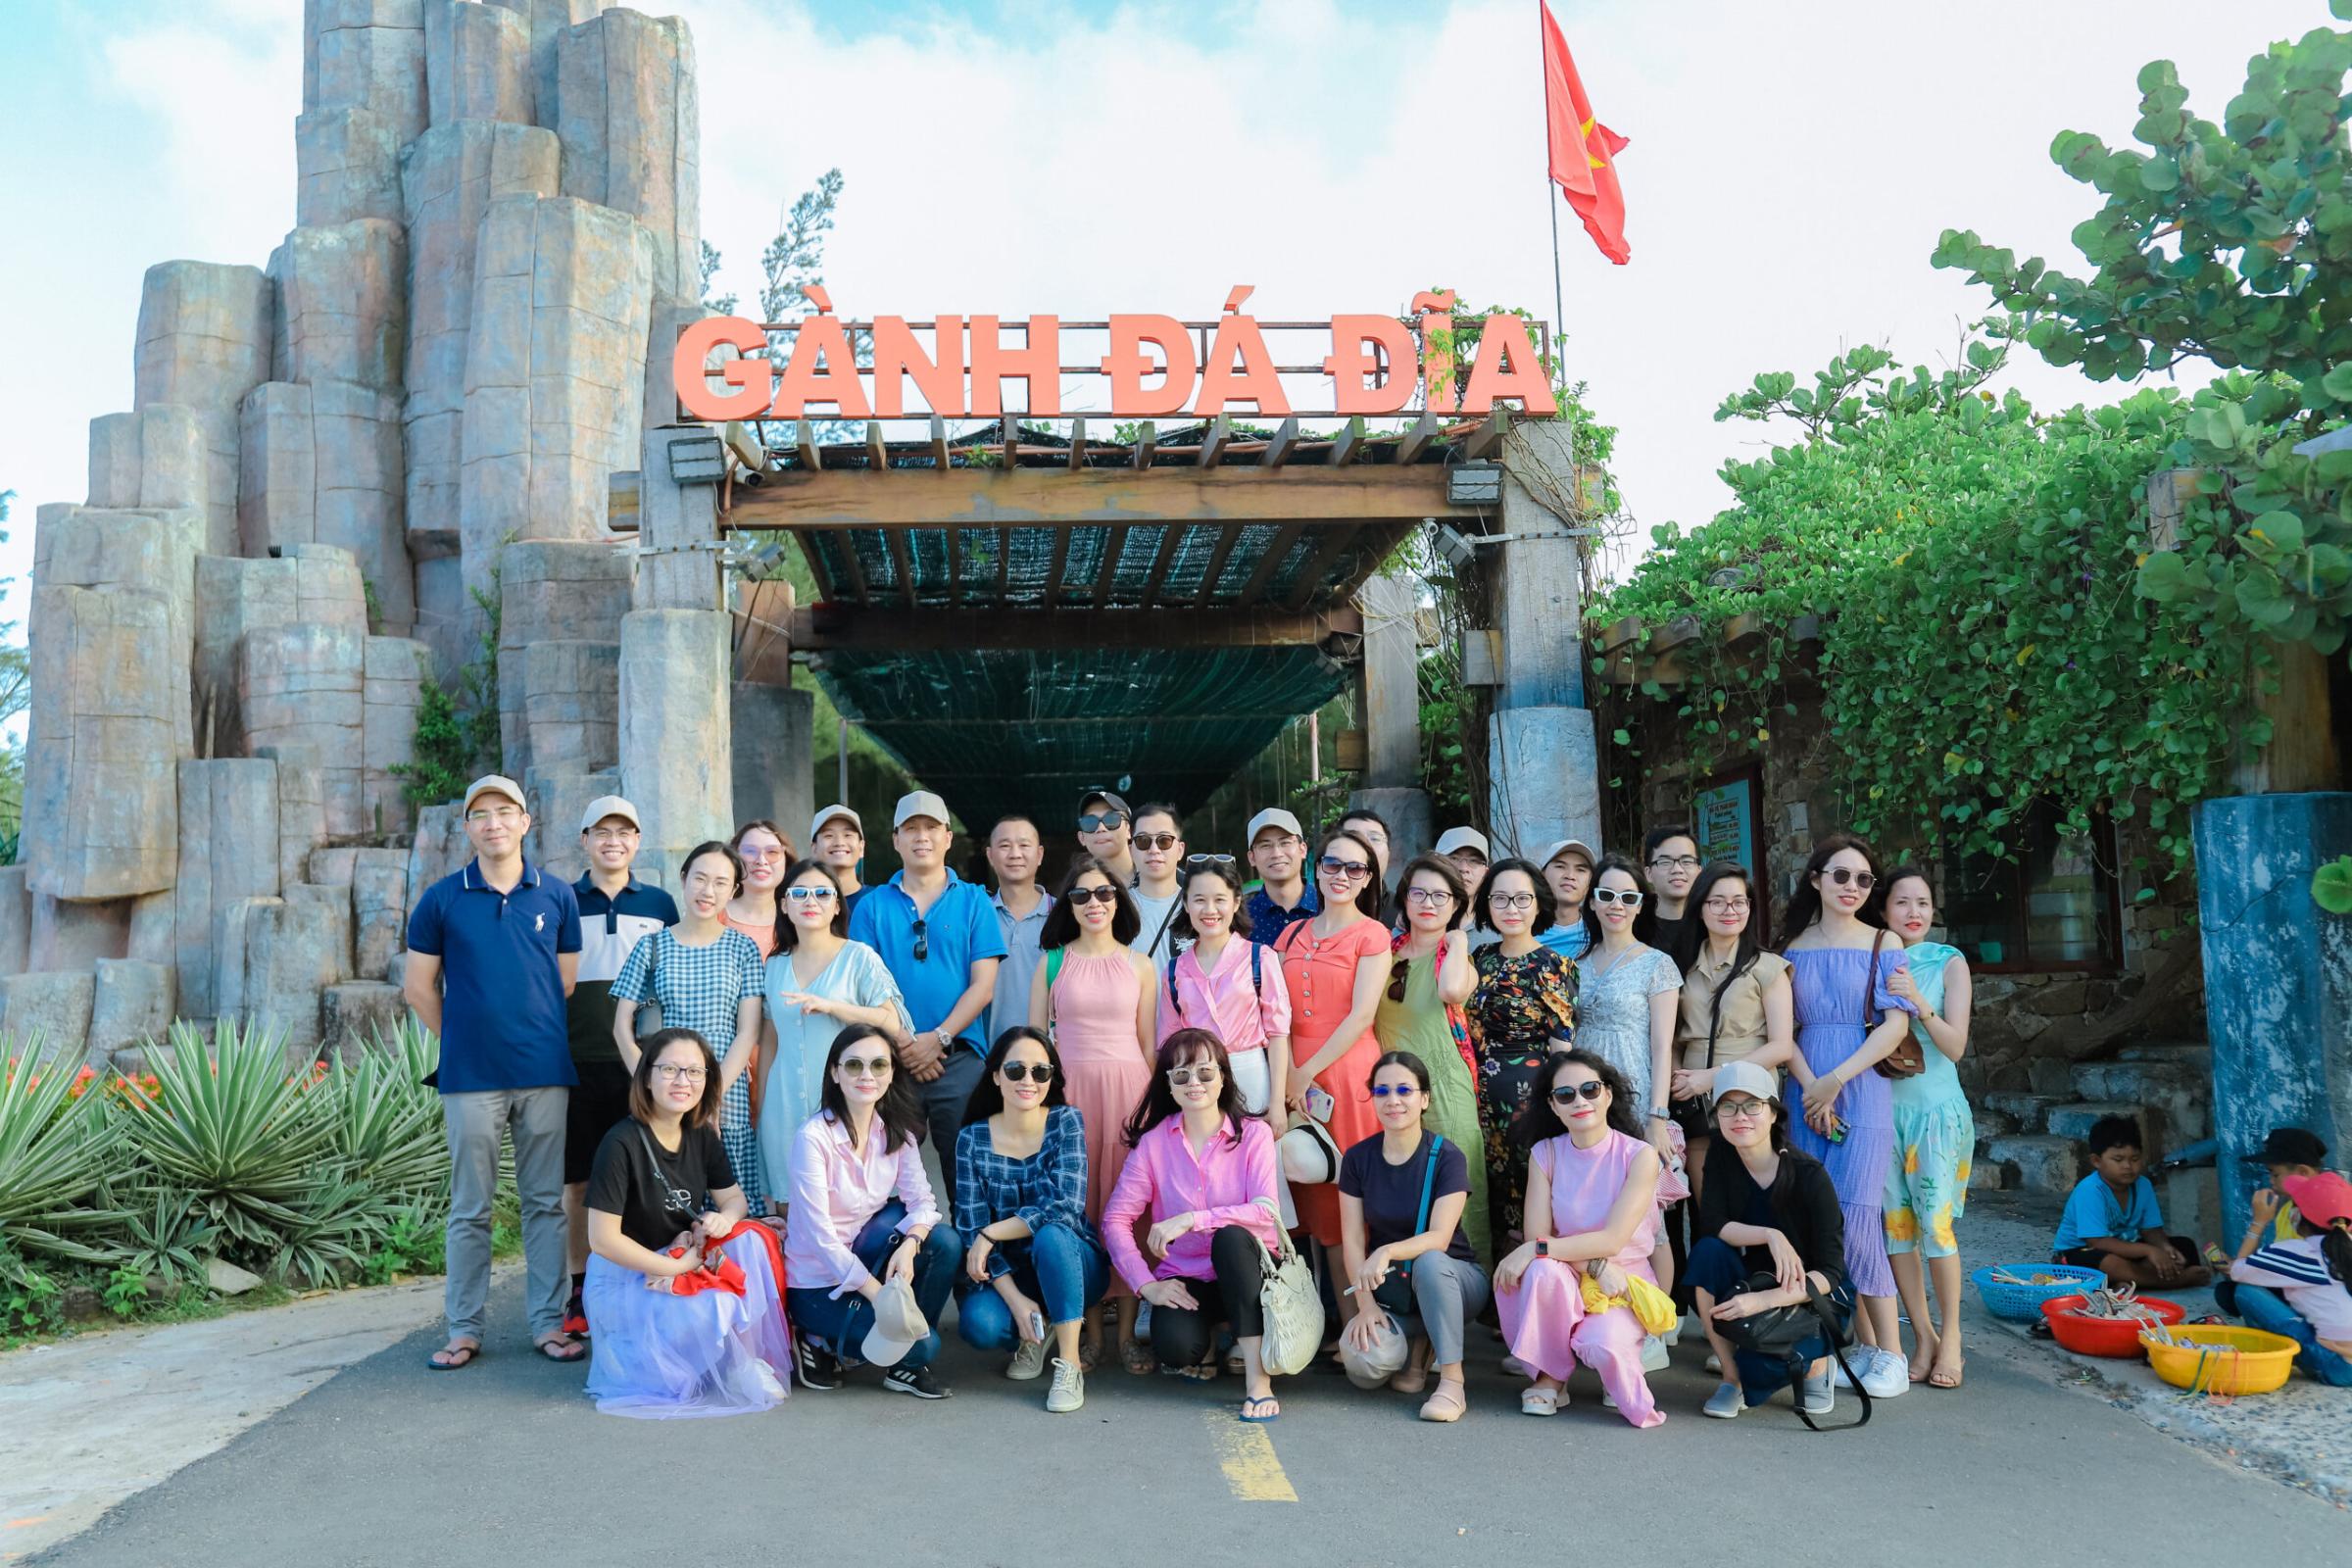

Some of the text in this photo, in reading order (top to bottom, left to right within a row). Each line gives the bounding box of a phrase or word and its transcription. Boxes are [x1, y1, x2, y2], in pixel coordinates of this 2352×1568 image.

[674, 285, 1559, 420] GÀNH ĐÁ ĐĨA
